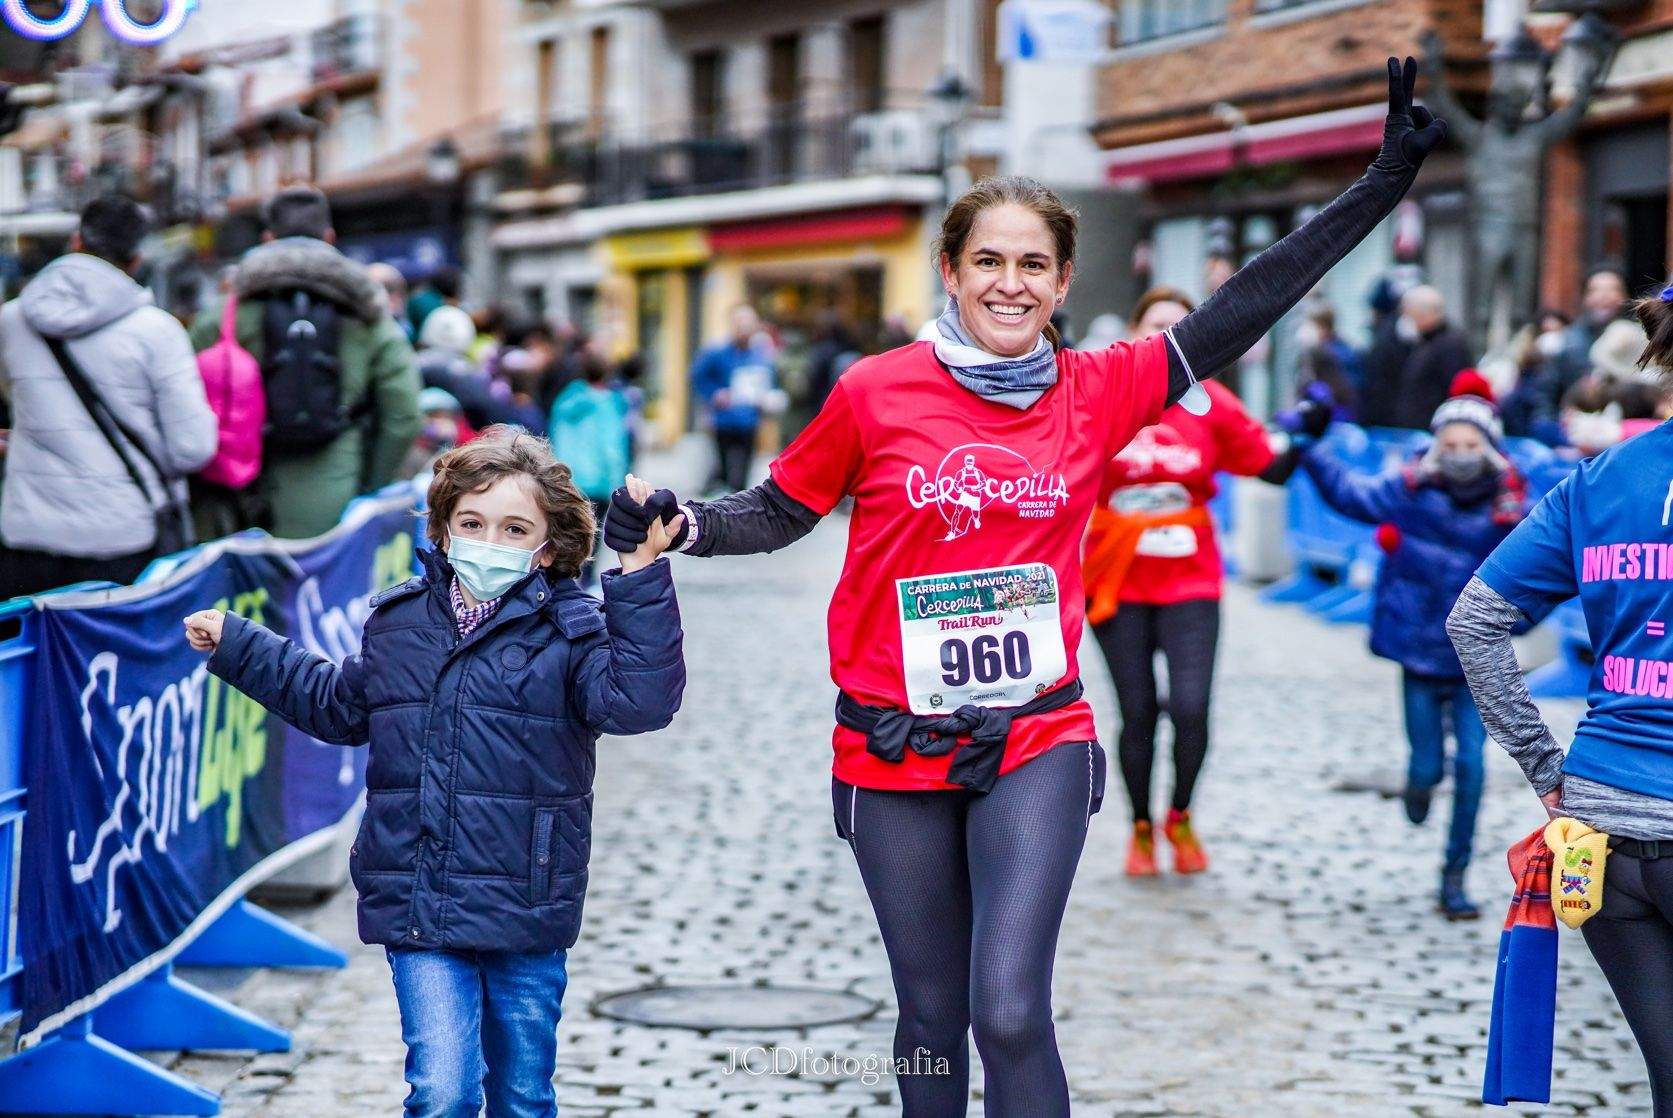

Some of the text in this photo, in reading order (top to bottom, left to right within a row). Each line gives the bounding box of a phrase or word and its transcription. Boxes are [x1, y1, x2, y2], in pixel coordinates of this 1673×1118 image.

[1019, 509, 1055, 518] NAVIDAD
[907, 582, 957, 595] CARRERA
[973, 574, 1022, 588] NAVIDAD
[1026, 571, 1046, 581] 2021
[940, 630, 1032, 687] 960
